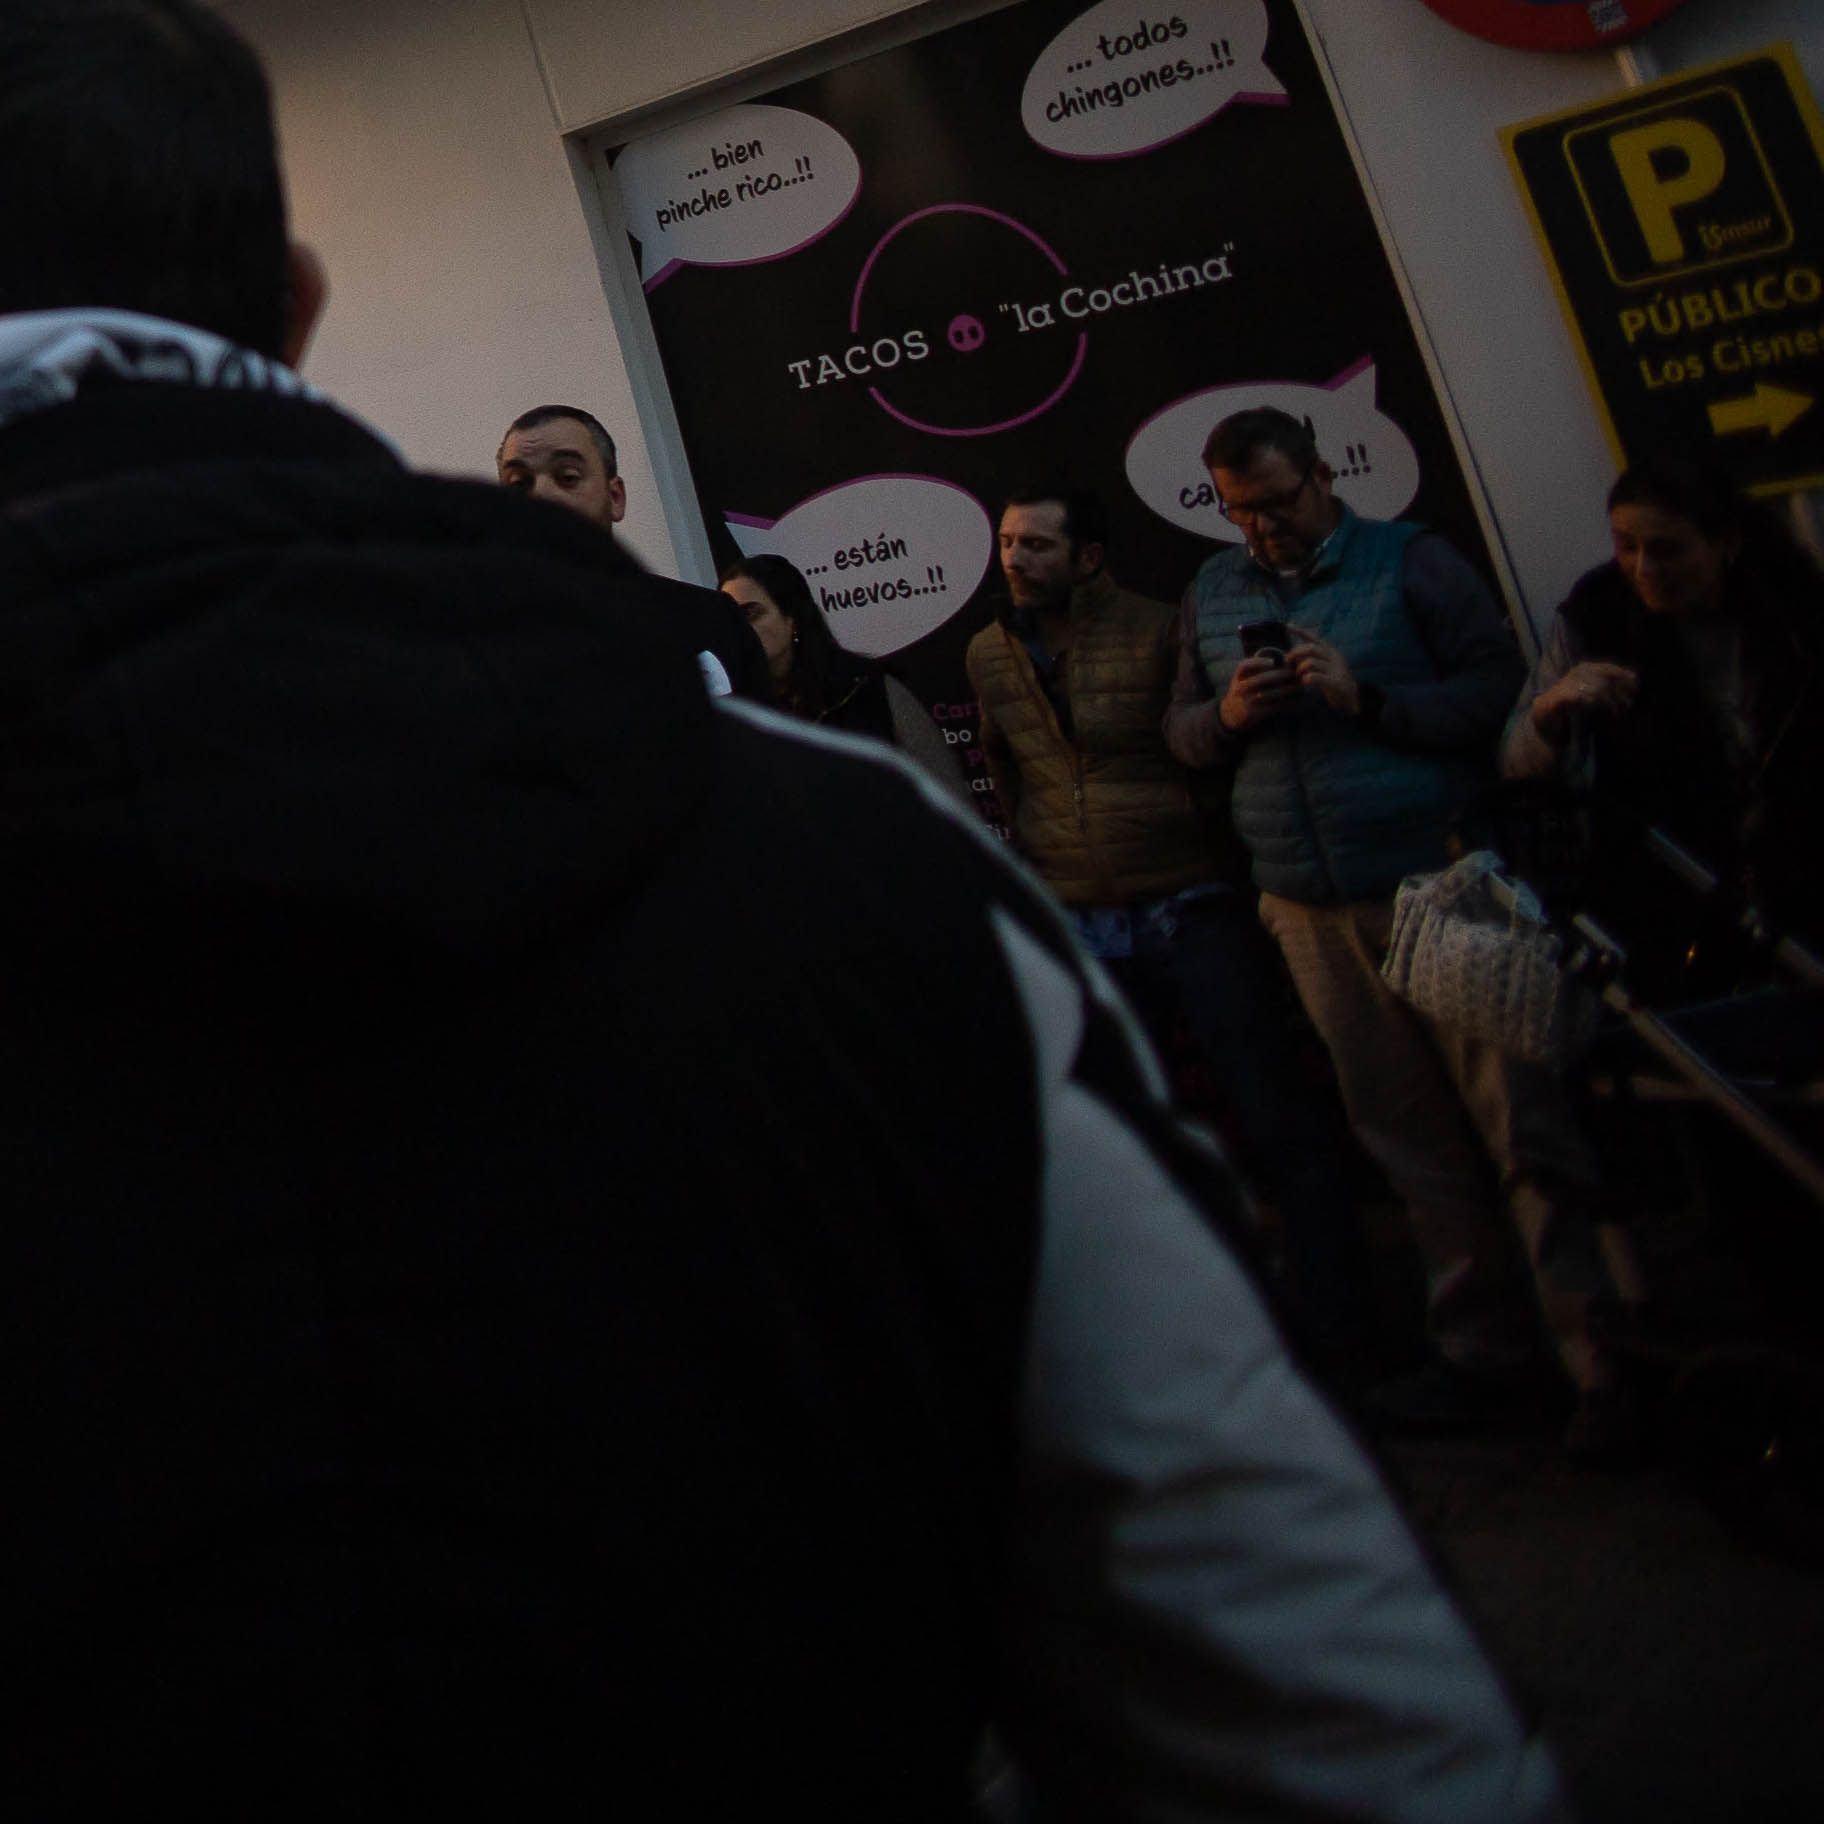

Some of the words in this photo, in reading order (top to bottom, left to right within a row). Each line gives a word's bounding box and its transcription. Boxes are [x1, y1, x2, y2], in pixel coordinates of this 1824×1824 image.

[1097, 16, 1188, 60] todos
[1045, 39, 1236, 122] chingones..!!
[711, 139, 764, 170] bien
[656, 188, 733, 232] pinche
[736, 156, 814, 202] rico..!!
[1609, 117, 1727, 264] P
[788, 329, 930, 390] TACOS
[1059, 241, 1237, 320] Cochina"
[1618, 266, 1822, 344] PÚBLICO
[1638, 352, 1705, 390] Los
[834, 532, 909, 571] están
[820, 565, 947, 613] huevos..!!
